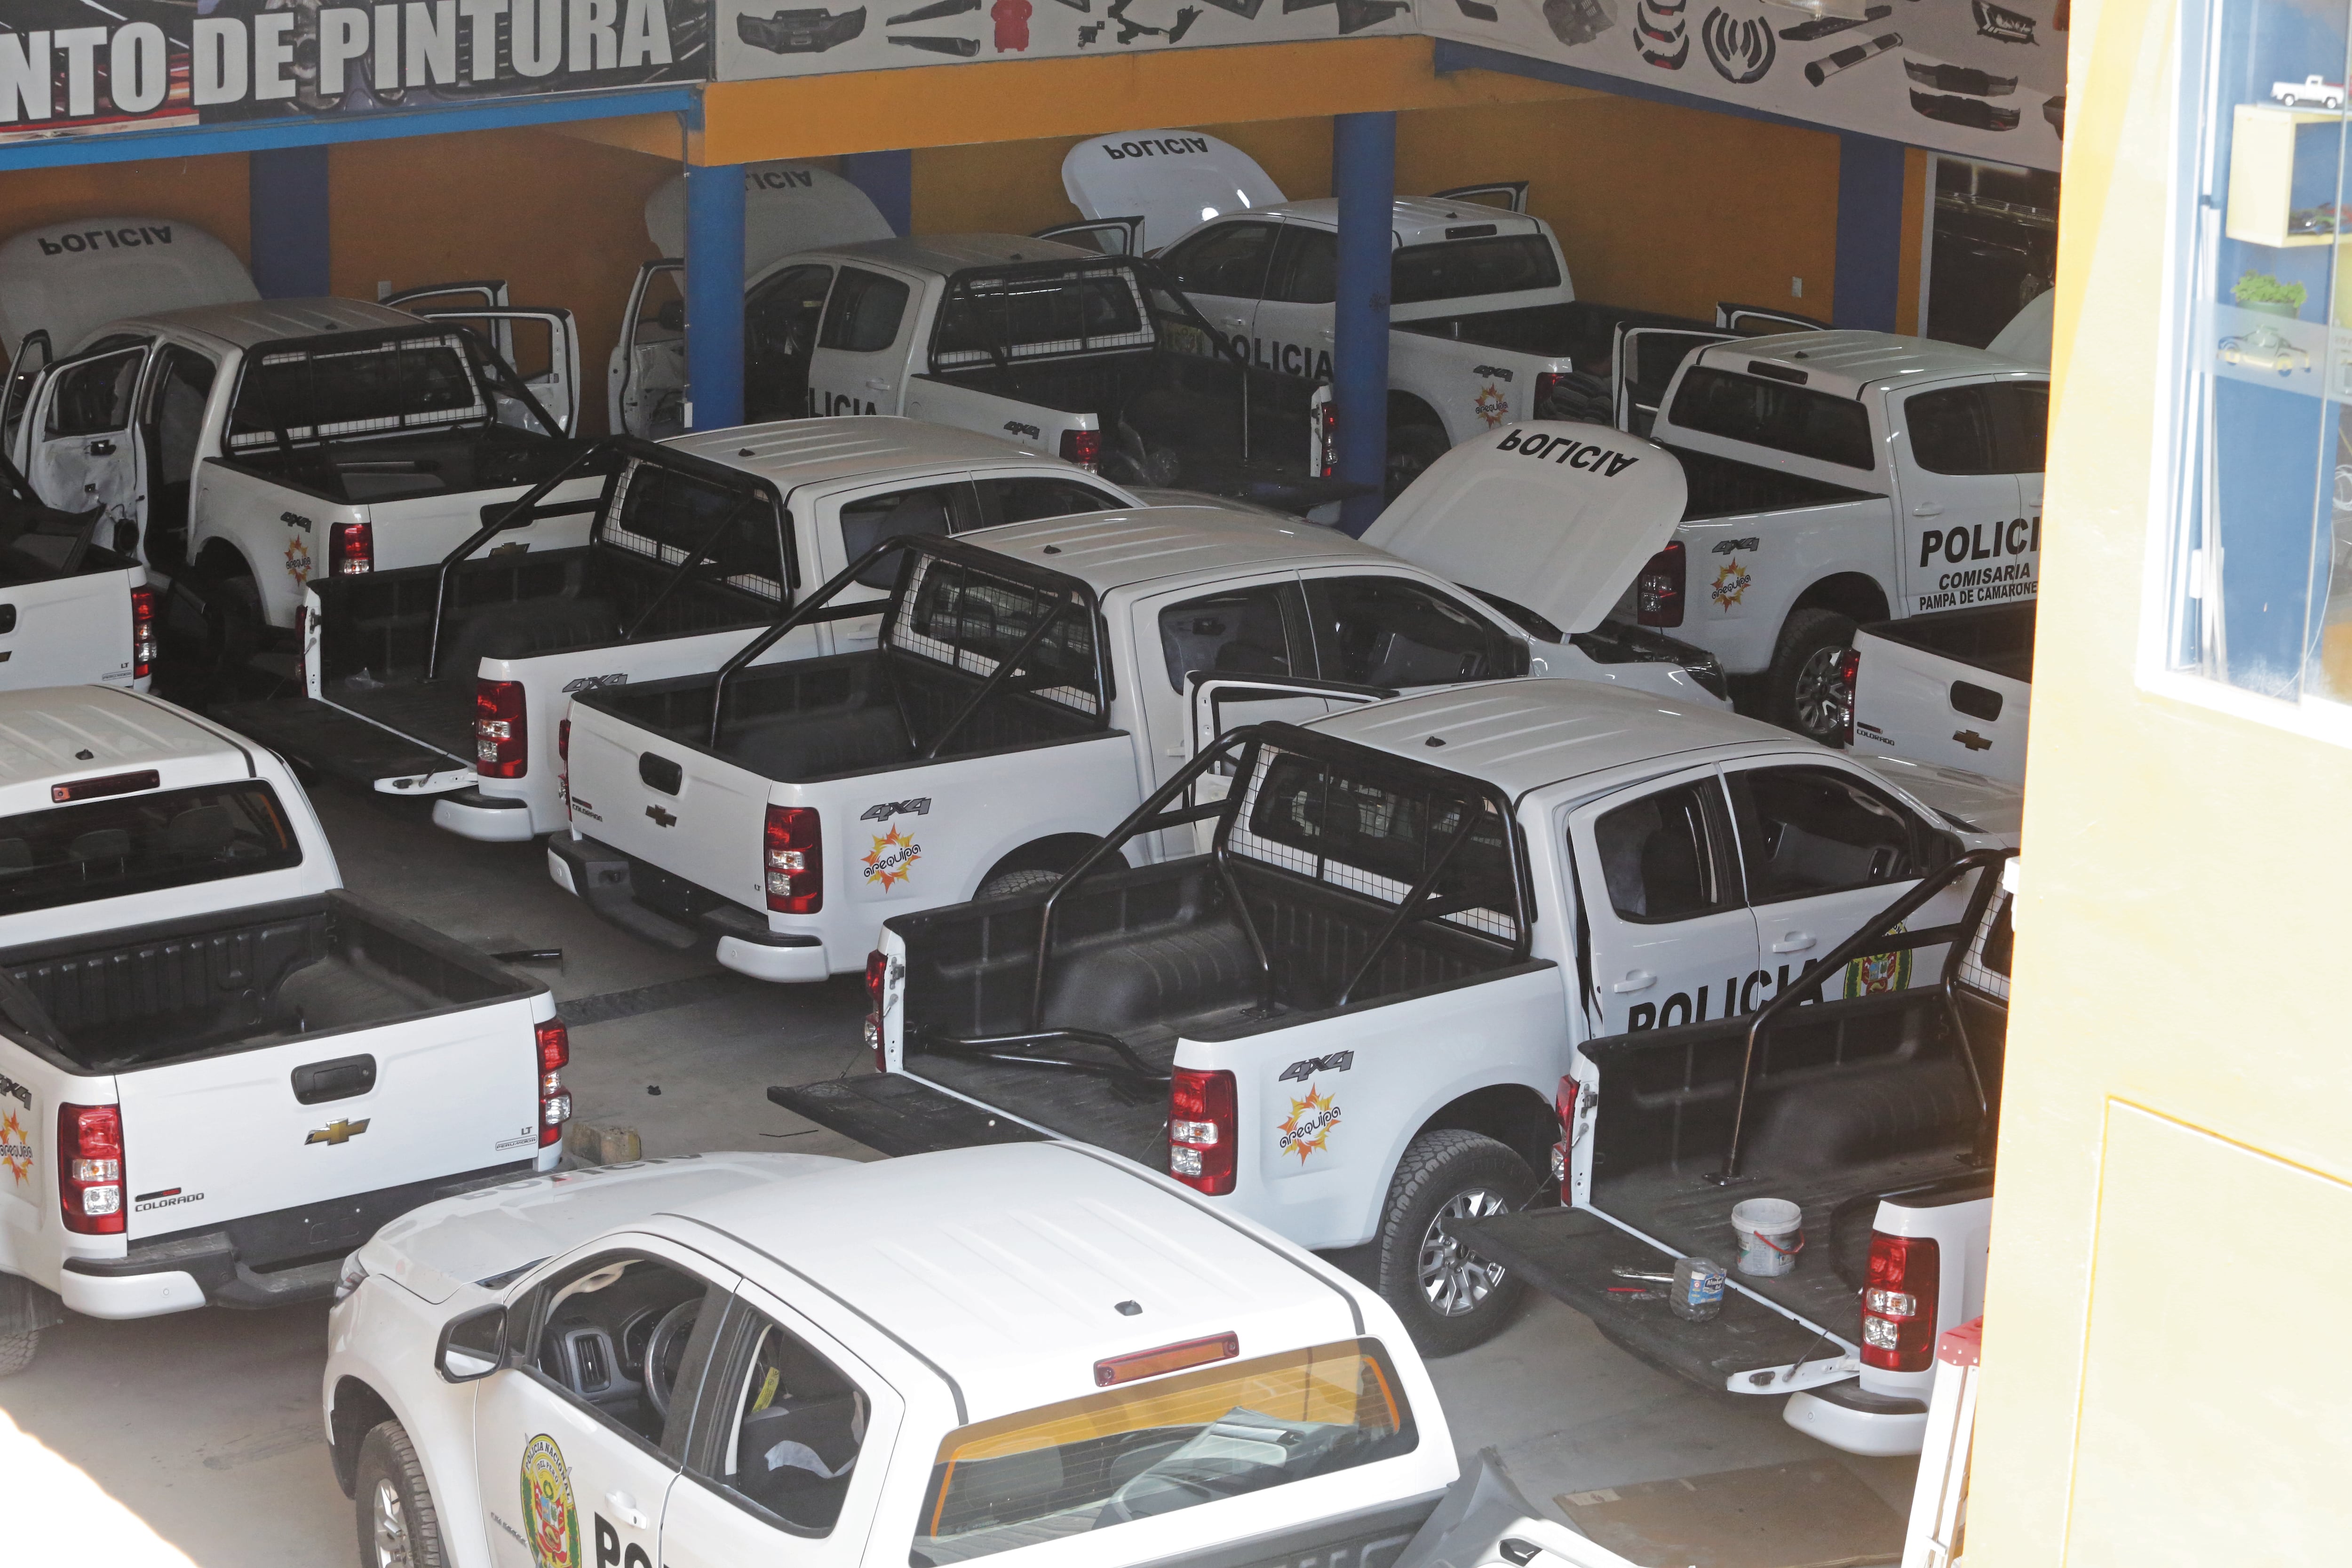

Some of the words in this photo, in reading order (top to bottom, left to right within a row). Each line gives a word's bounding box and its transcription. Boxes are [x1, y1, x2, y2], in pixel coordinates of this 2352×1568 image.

[193, 12, 296, 105] DE
[320, 0, 673, 94] PINTURA
[1920, 516, 2042, 567] POLICI
[1939, 563, 2030, 590] COMISARIA
[1920, 592, 1956, 611] PAMPA
[1960, 589, 1974, 604] DE
[521, 1126, 532, 1135] LT
[135, 1193, 204, 1212] COLORADO
[525, 1442, 544, 1470] POLICIA
